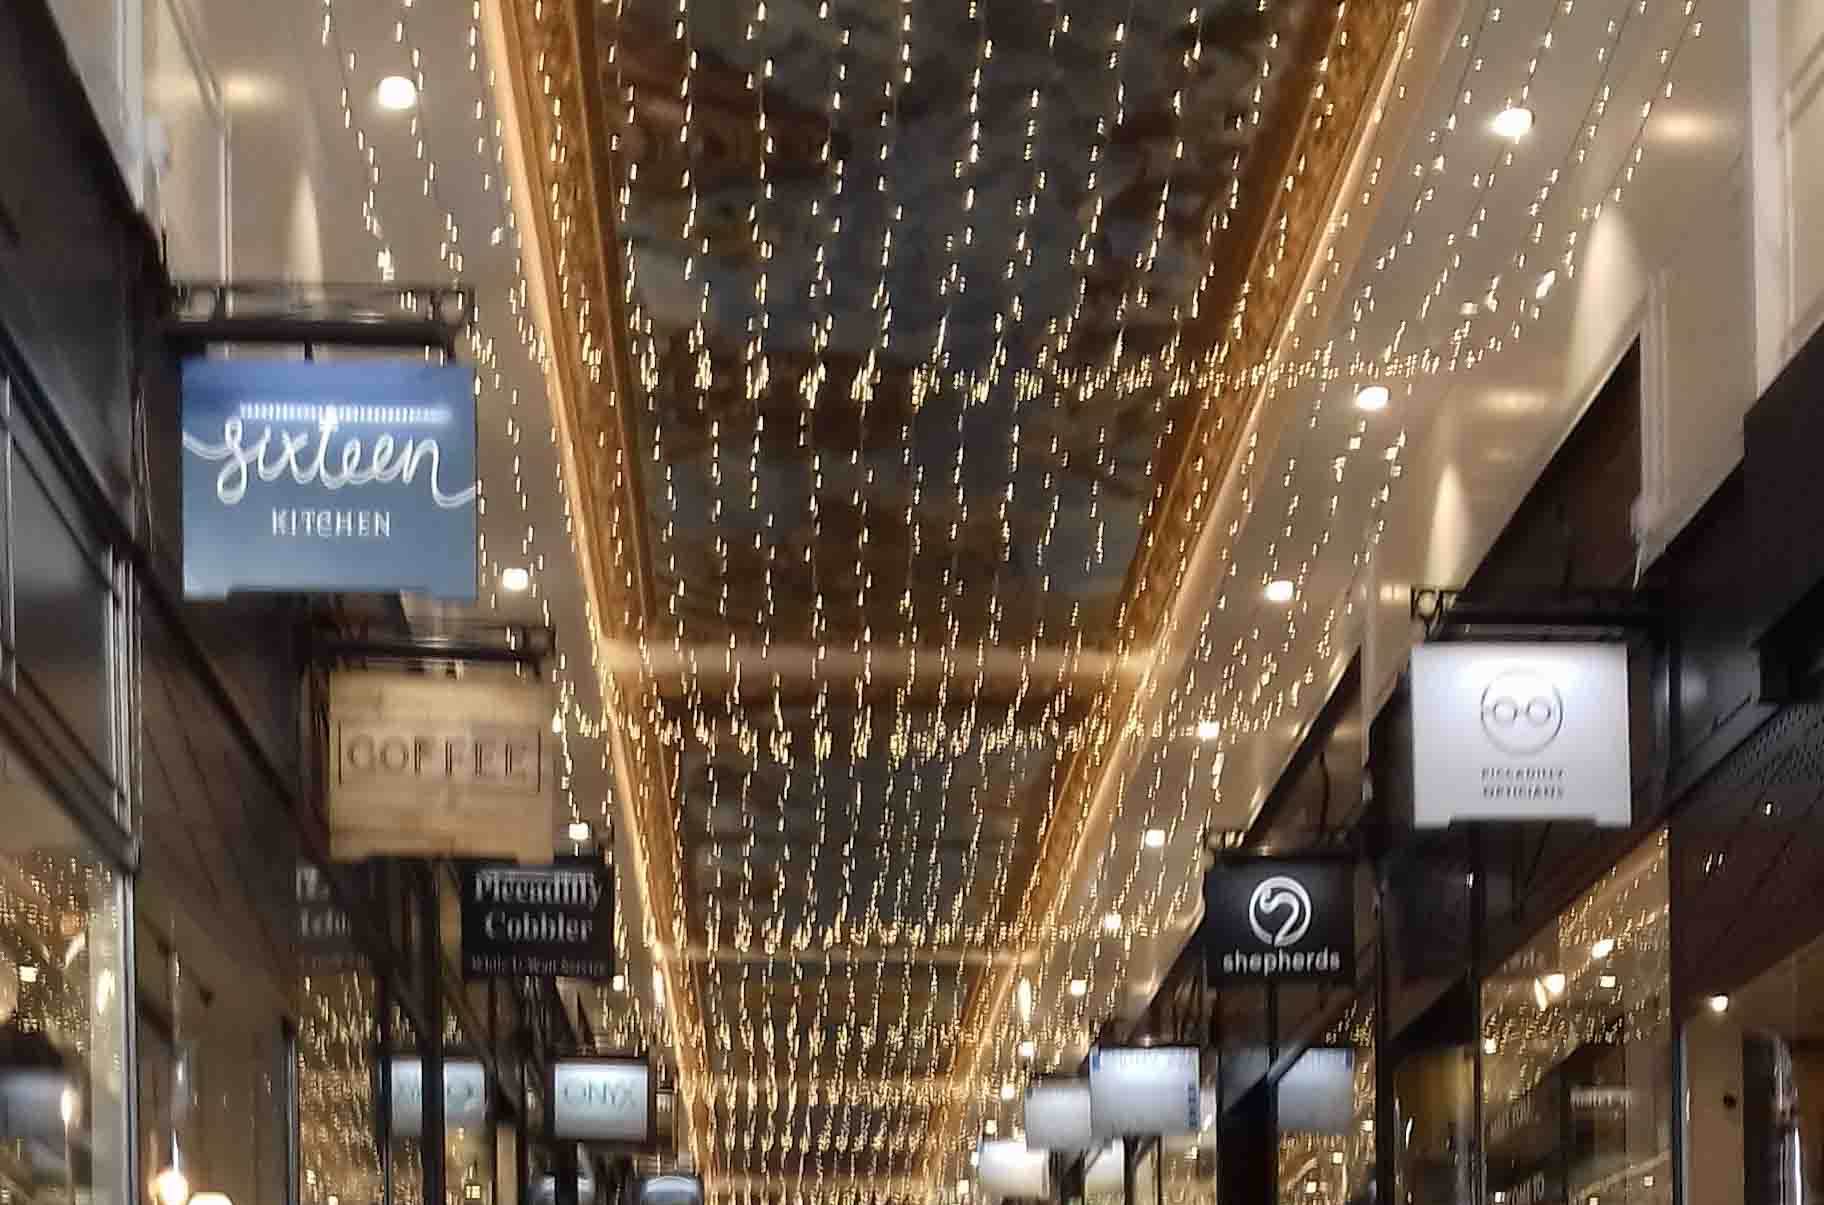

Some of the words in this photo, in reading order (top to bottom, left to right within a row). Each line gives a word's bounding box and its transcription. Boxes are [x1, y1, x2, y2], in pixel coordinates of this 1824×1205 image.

[271, 507, 391, 537] KITCHEN
[484, 911, 593, 943] Cobbler
[1223, 946, 1340, 976] shepherds
